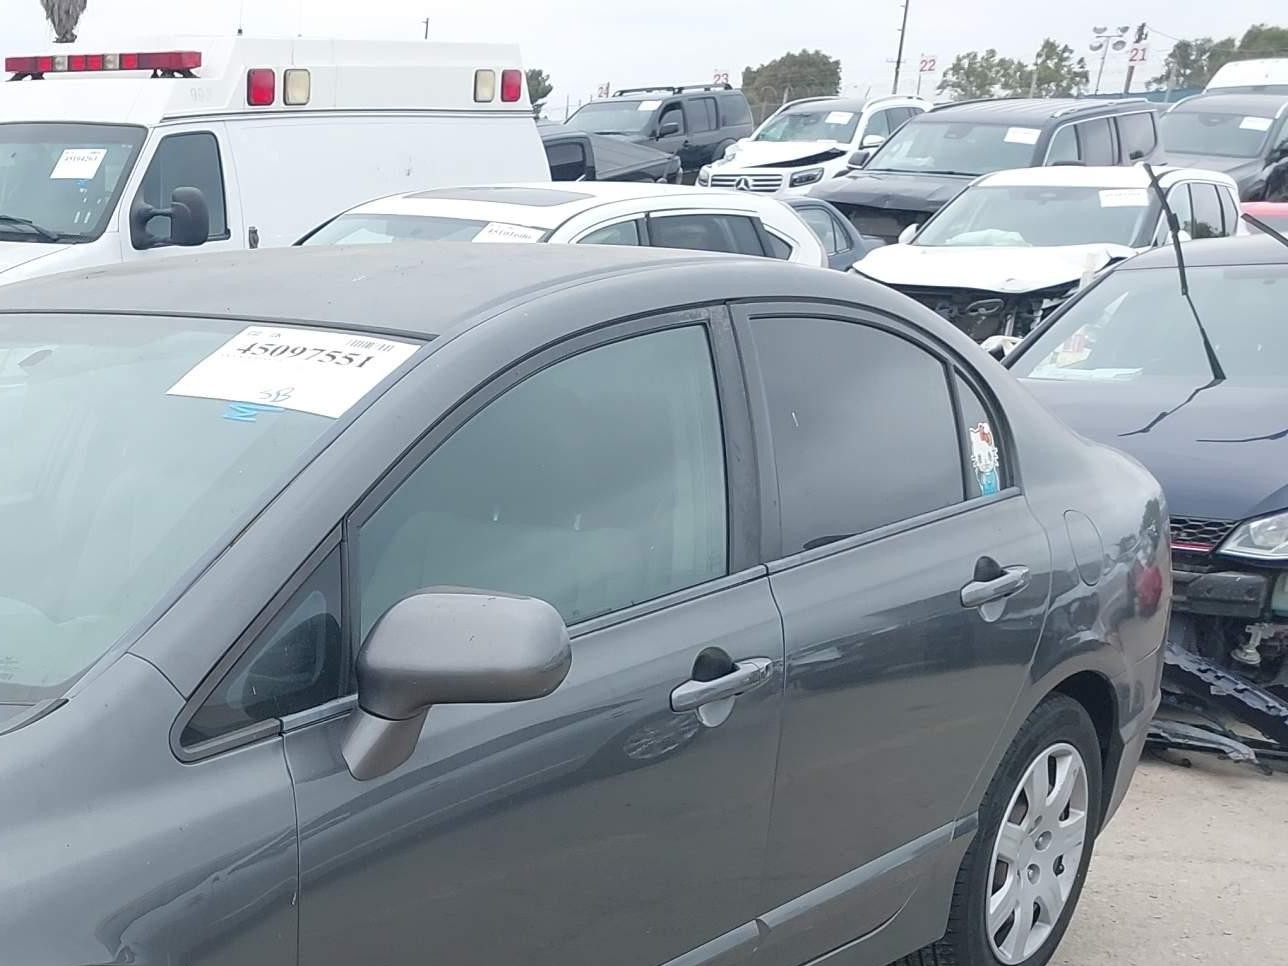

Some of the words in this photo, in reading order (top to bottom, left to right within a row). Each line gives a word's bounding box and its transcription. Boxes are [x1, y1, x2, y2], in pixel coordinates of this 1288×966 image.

[1128, 47, 1147, 62] 21
[919, 59, 937, 73] 22
[713, 73, 729, 85] 23
[237, 342, 374, 368] 45097551
